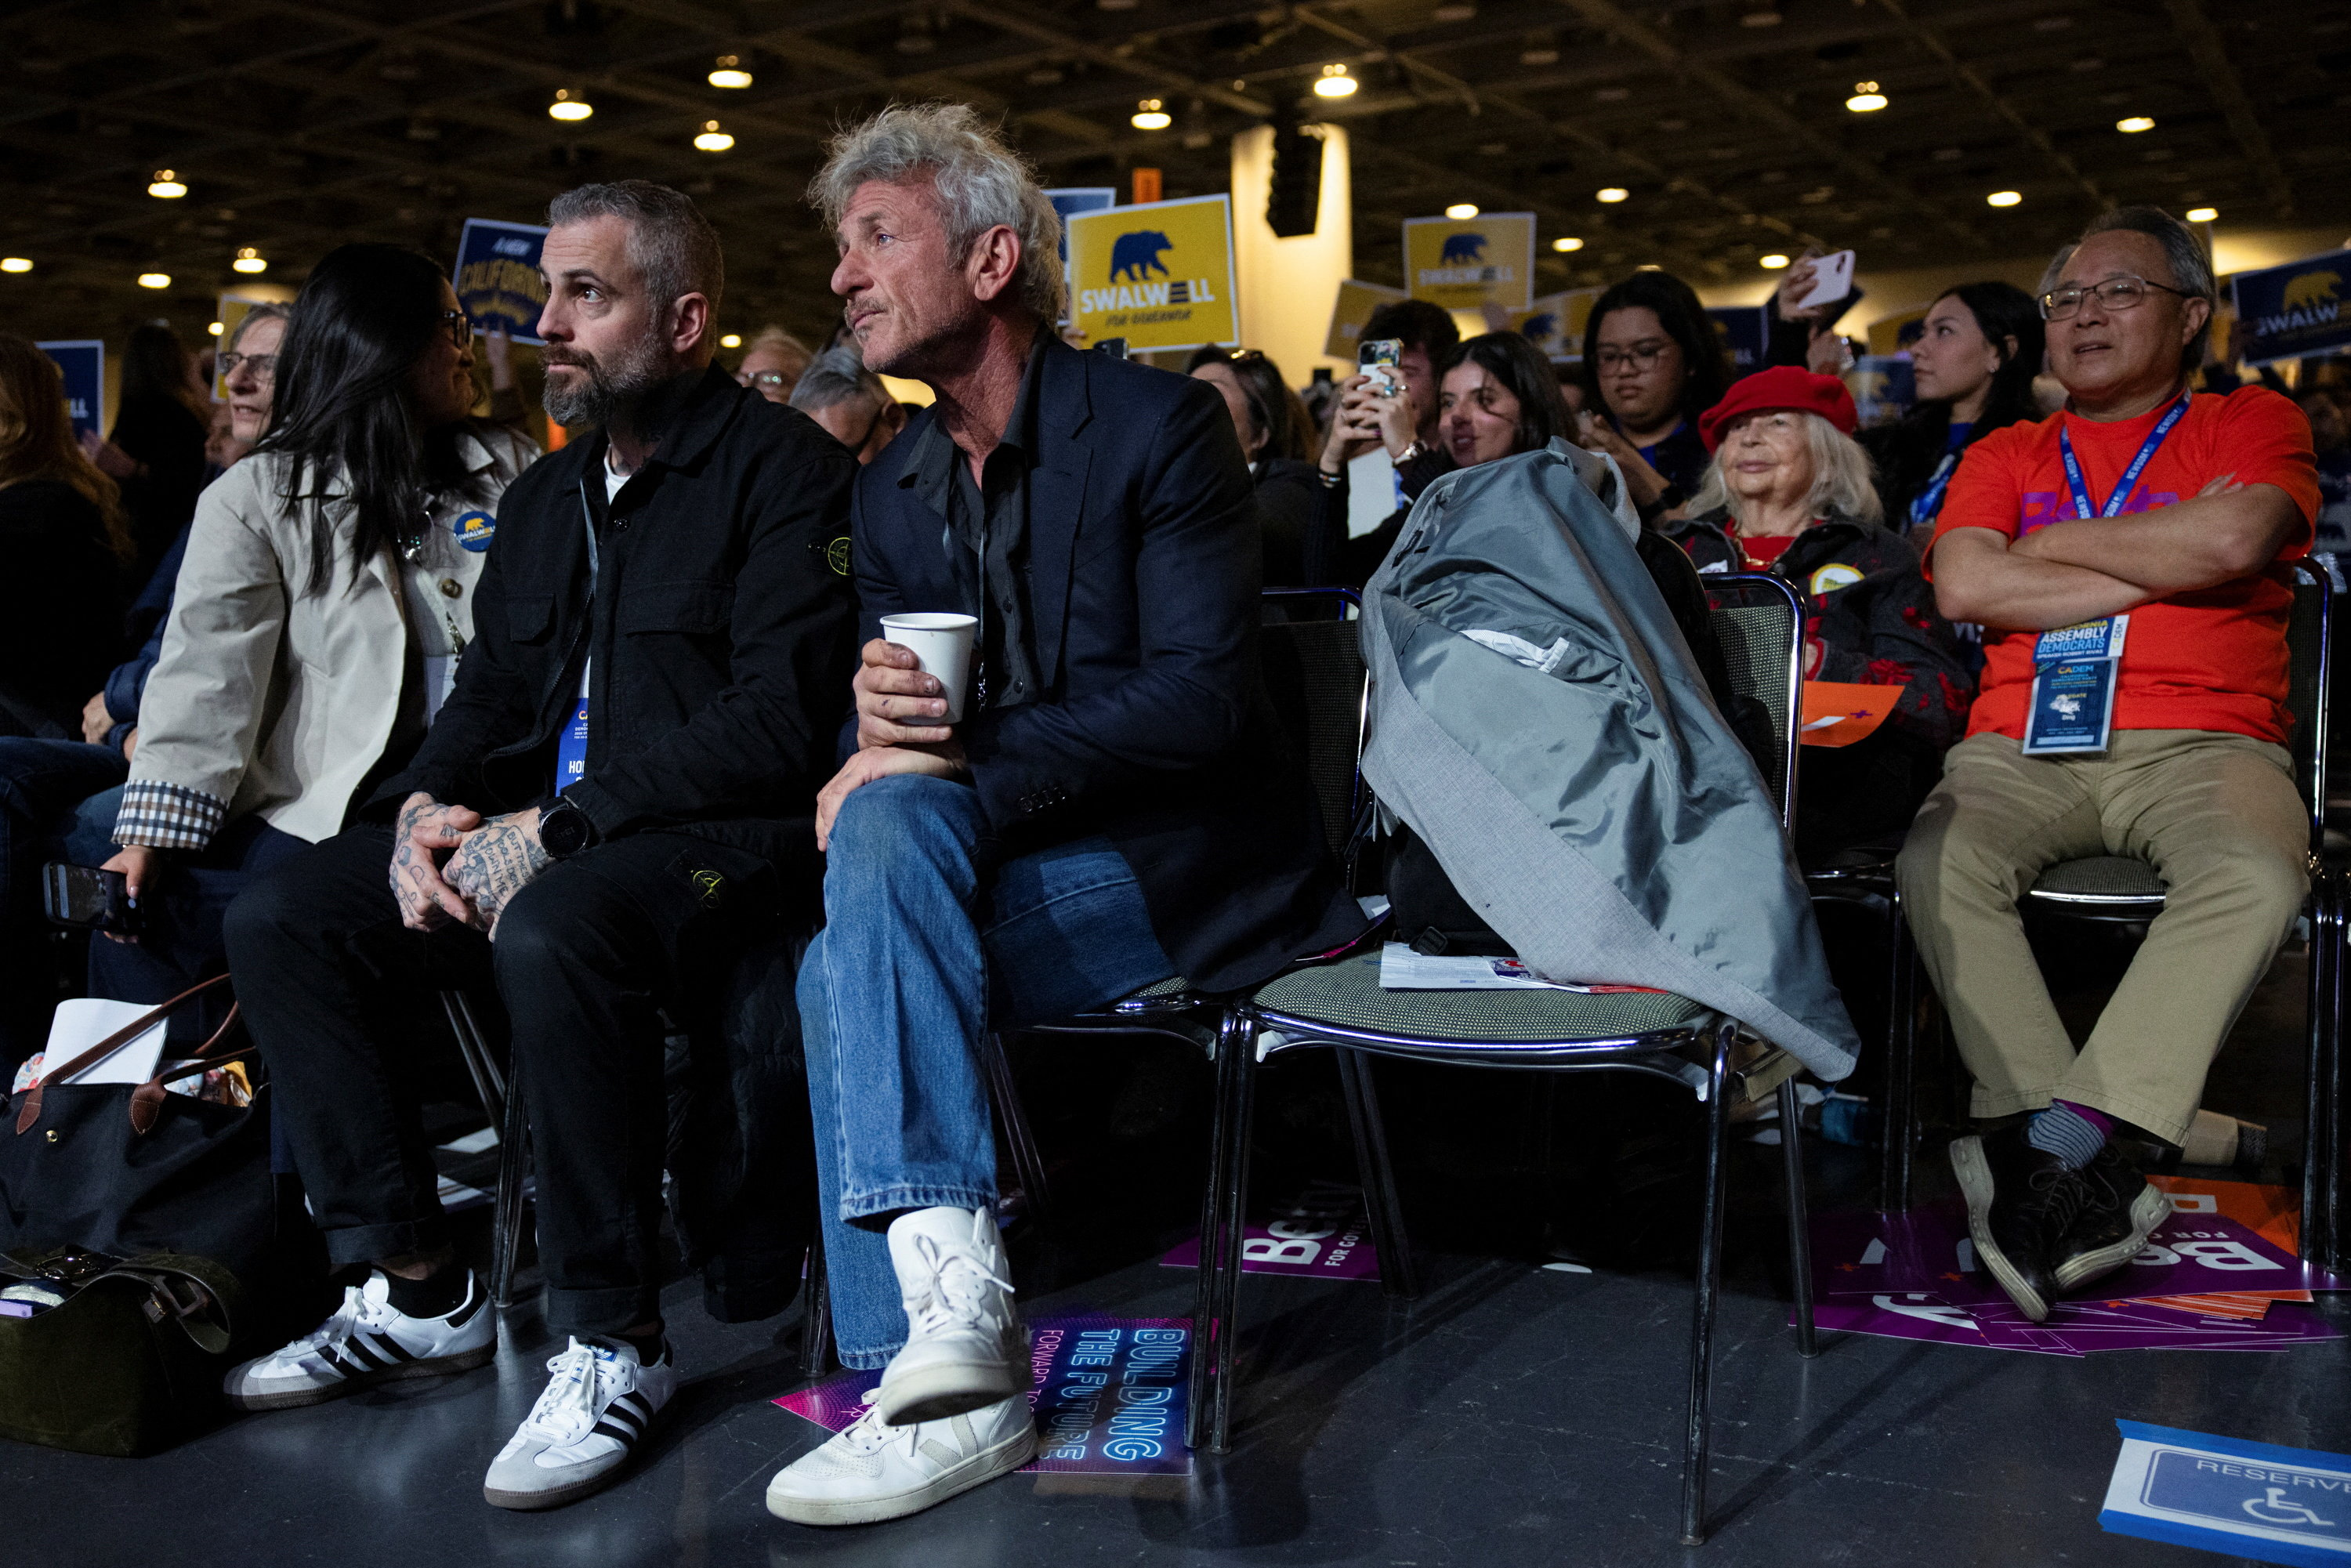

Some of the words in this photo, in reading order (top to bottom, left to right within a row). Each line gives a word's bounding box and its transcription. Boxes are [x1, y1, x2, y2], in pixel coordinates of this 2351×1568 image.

[1081, 278, 1215, 313] SWALWELL
[2038, 638, 2106, 654] DEMOCRATS
[2040, 627, 2108, 643] ASSEMBLY
[2057, 664, 2095, 674] CADEM
[507, 831, 521, 850] BUT
[485, 848, 502, 875] OWN
[494, 873, 509, 897] ME
[1324, 1249, 1349, 1267] FOR
[1031, 1331, 1064, 1384] FORWARD
[1070, 1328, 1121, 1366] THE
[1103, 1328, 1187, 1461] BUILDING
[1041, 1372, 1107, 1460] FUTURE
[2197, 1460, 2351, 1493] RESERVE
